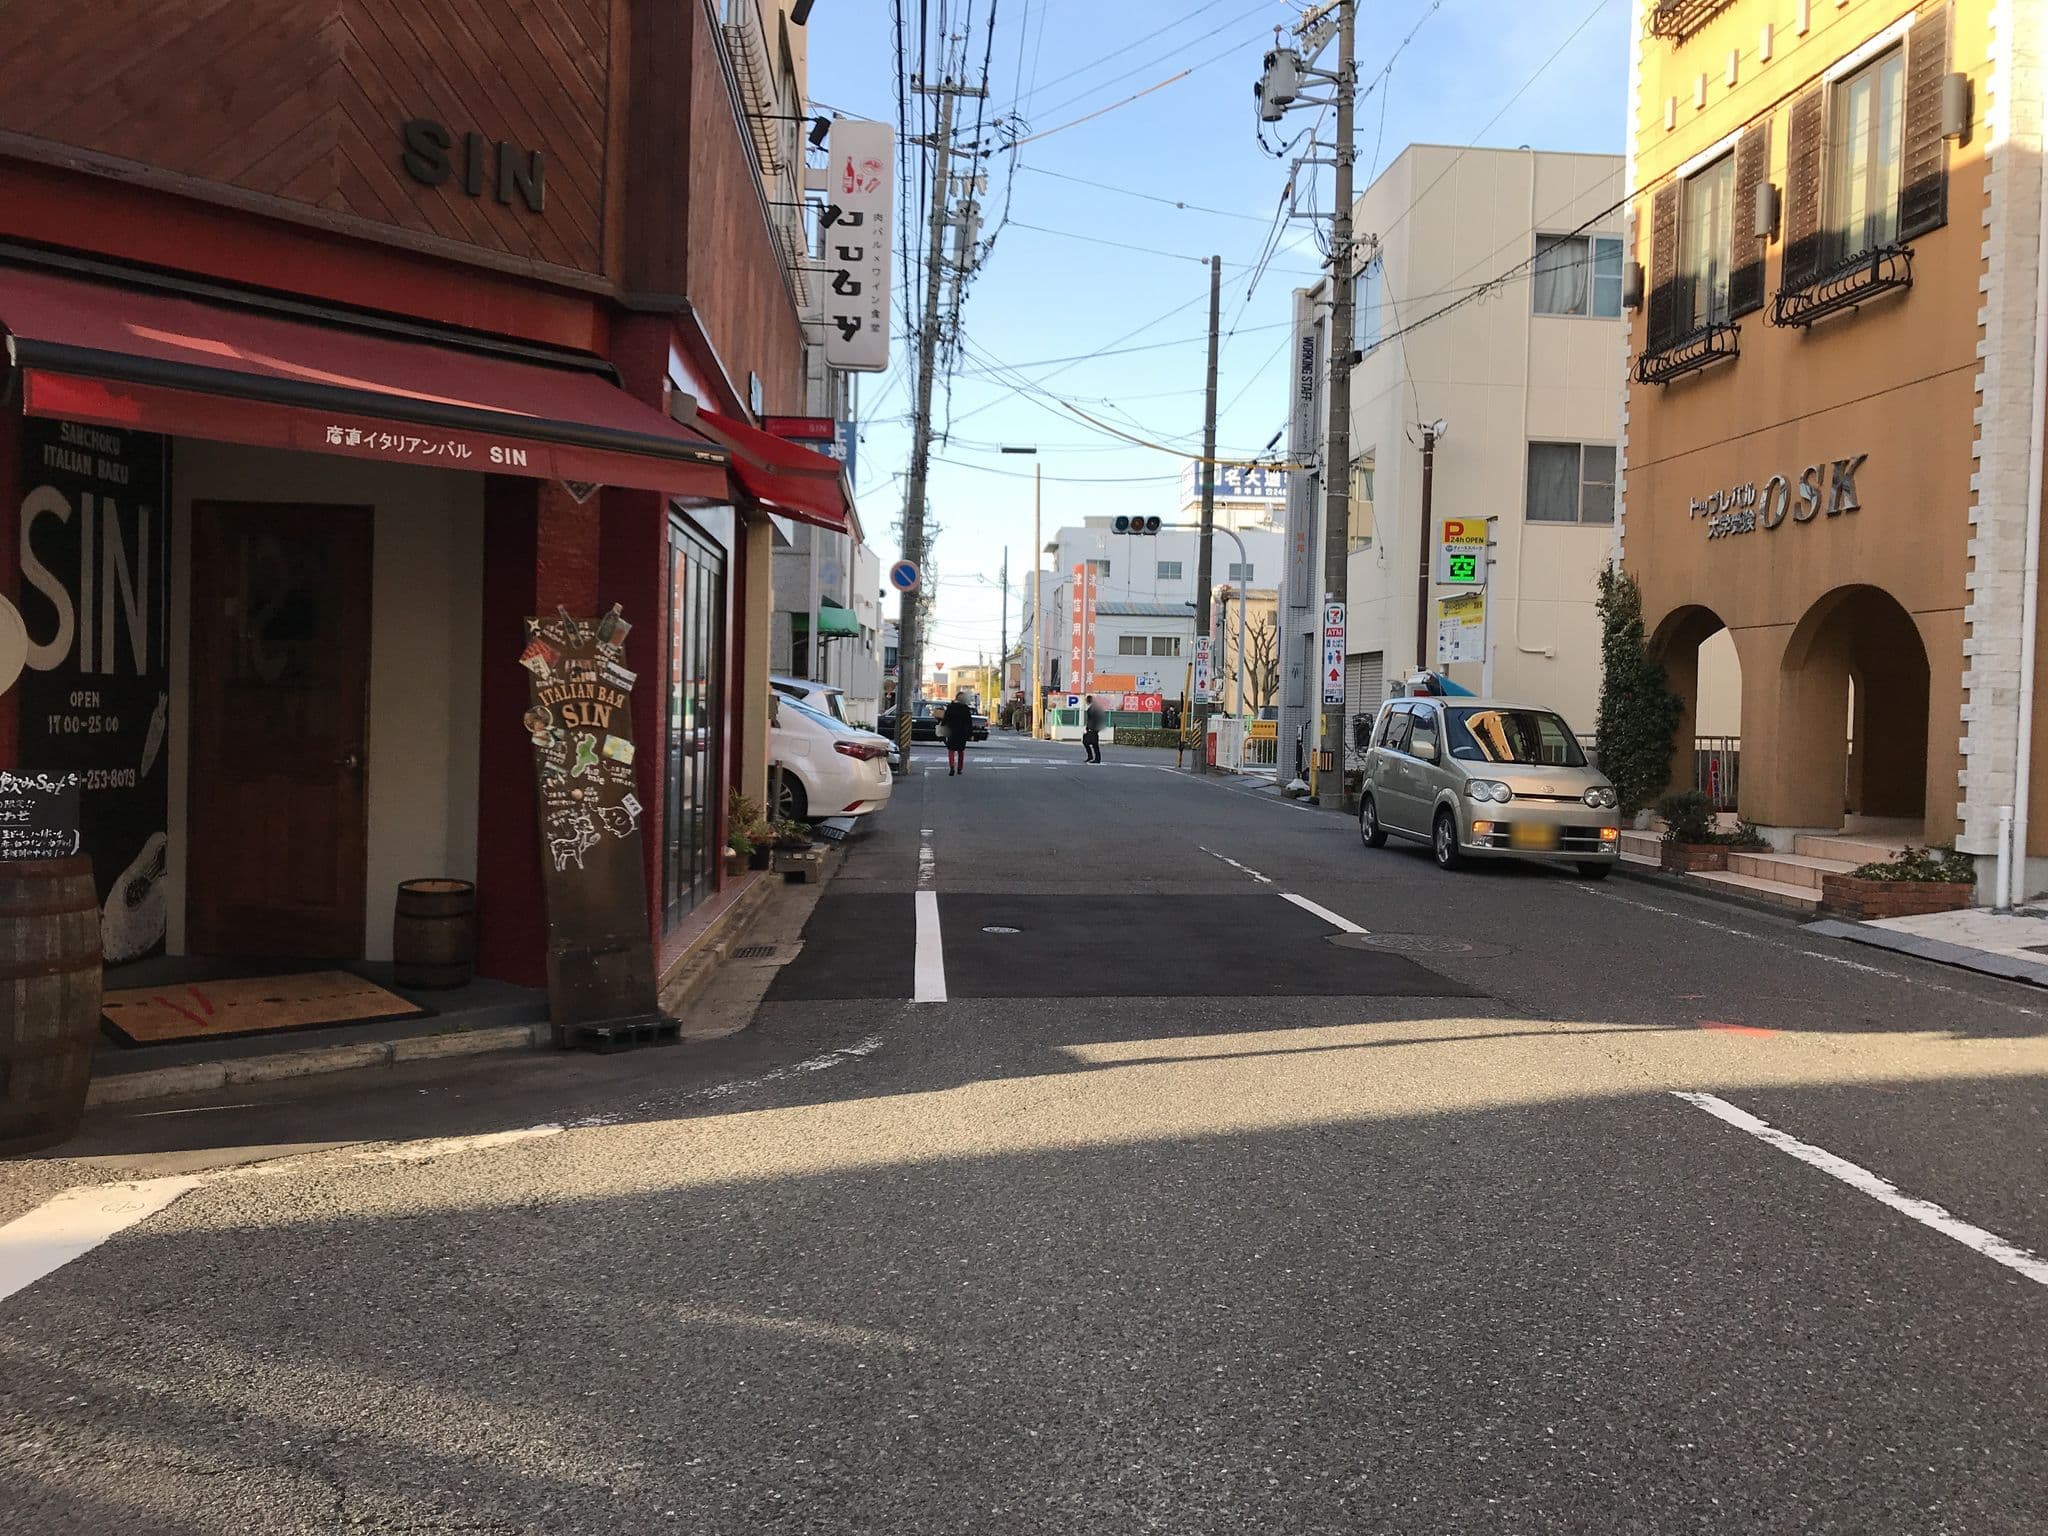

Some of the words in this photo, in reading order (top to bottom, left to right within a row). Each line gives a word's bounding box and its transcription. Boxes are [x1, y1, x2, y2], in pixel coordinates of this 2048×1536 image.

[402, 118, 546, 213] SIN
[1302, 336, 1315, 375] WORKING
[1301, 376, 1313, 401] STAFF
[60, 422, 121, 456] SANCHOKU
[44, 444, 92, 477] ITALIAN
[489, 446, 528, 467] SIN
[1760, 453, 1869, 529] OSK
[1445, 521, 1465, 543] P
[20, 485, 150, 676] SIN
[1450, 555, 1475, 581] 空
[1071, 572, 1083, 685] 津信用金庫
[1327, 629, 1343, 637] ATM
[70, 690, 101, 708] OPEN
[538, 683, 595, 706] ITALIAN
[1068, 696, 1079, 707] P
[562, 701, 612, 728] SIN
[79, 768, 136, 790] -253-8079
